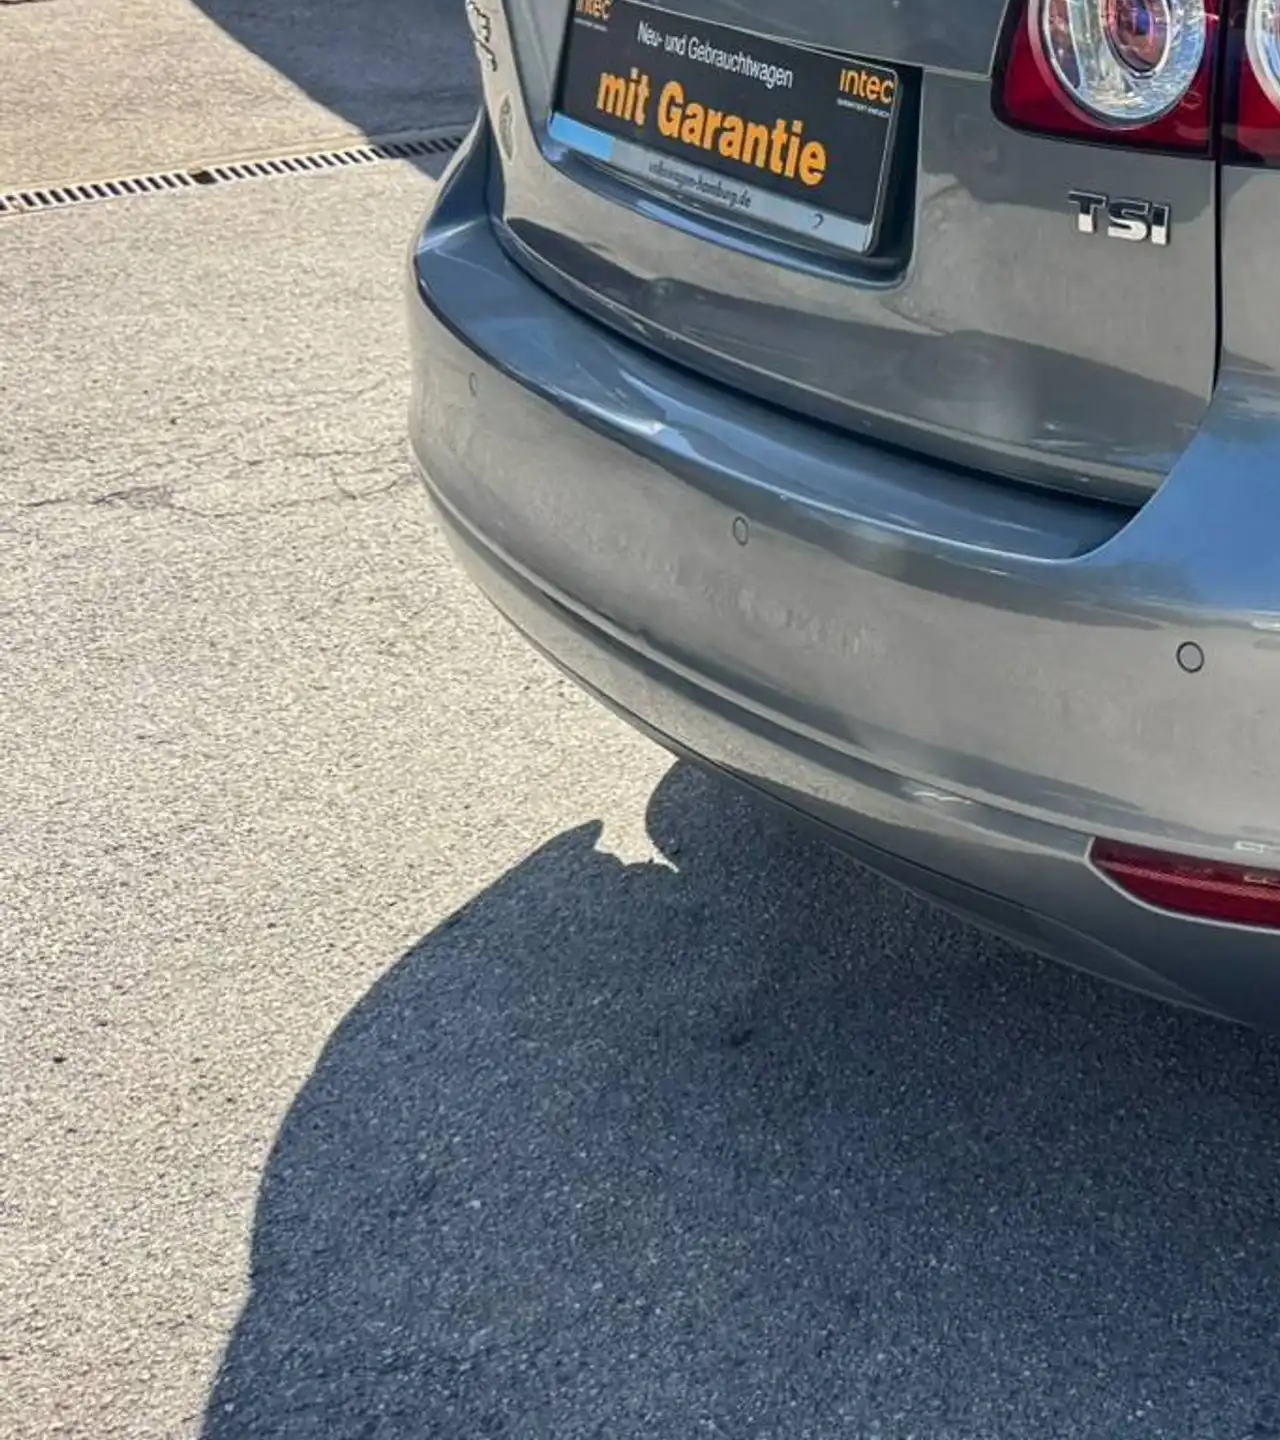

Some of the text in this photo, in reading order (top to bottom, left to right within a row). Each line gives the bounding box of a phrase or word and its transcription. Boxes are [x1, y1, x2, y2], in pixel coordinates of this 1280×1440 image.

[637, 19, 663, 47] Neu-
[663, 34, 687, 56] und
[688, 35, 794, 89] Gebrauchtwagen
[839, 67, 894, 104] intec
[595, 66, 827, 187] mit Garantie
[1067, 189, 1171, 246] TSI
